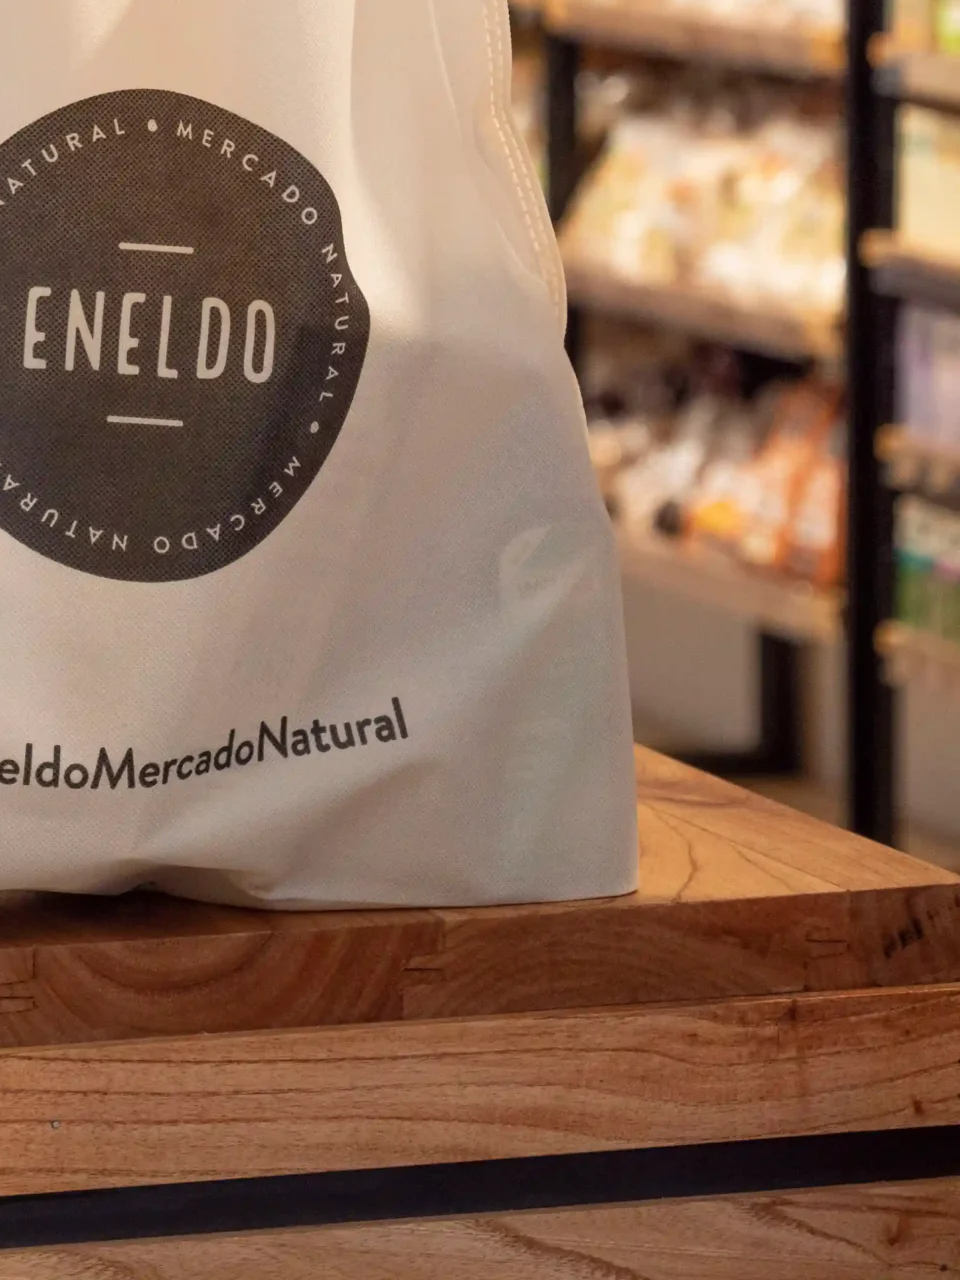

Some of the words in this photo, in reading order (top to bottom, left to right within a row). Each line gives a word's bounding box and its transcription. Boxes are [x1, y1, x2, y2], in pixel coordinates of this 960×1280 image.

[176, 120, 323, 228] MERCADO
[318, 241, 350, 402] NATURAL
[22, 285, 276, 385] ENELDO
[152, 455, 301, 555] MERCADO
